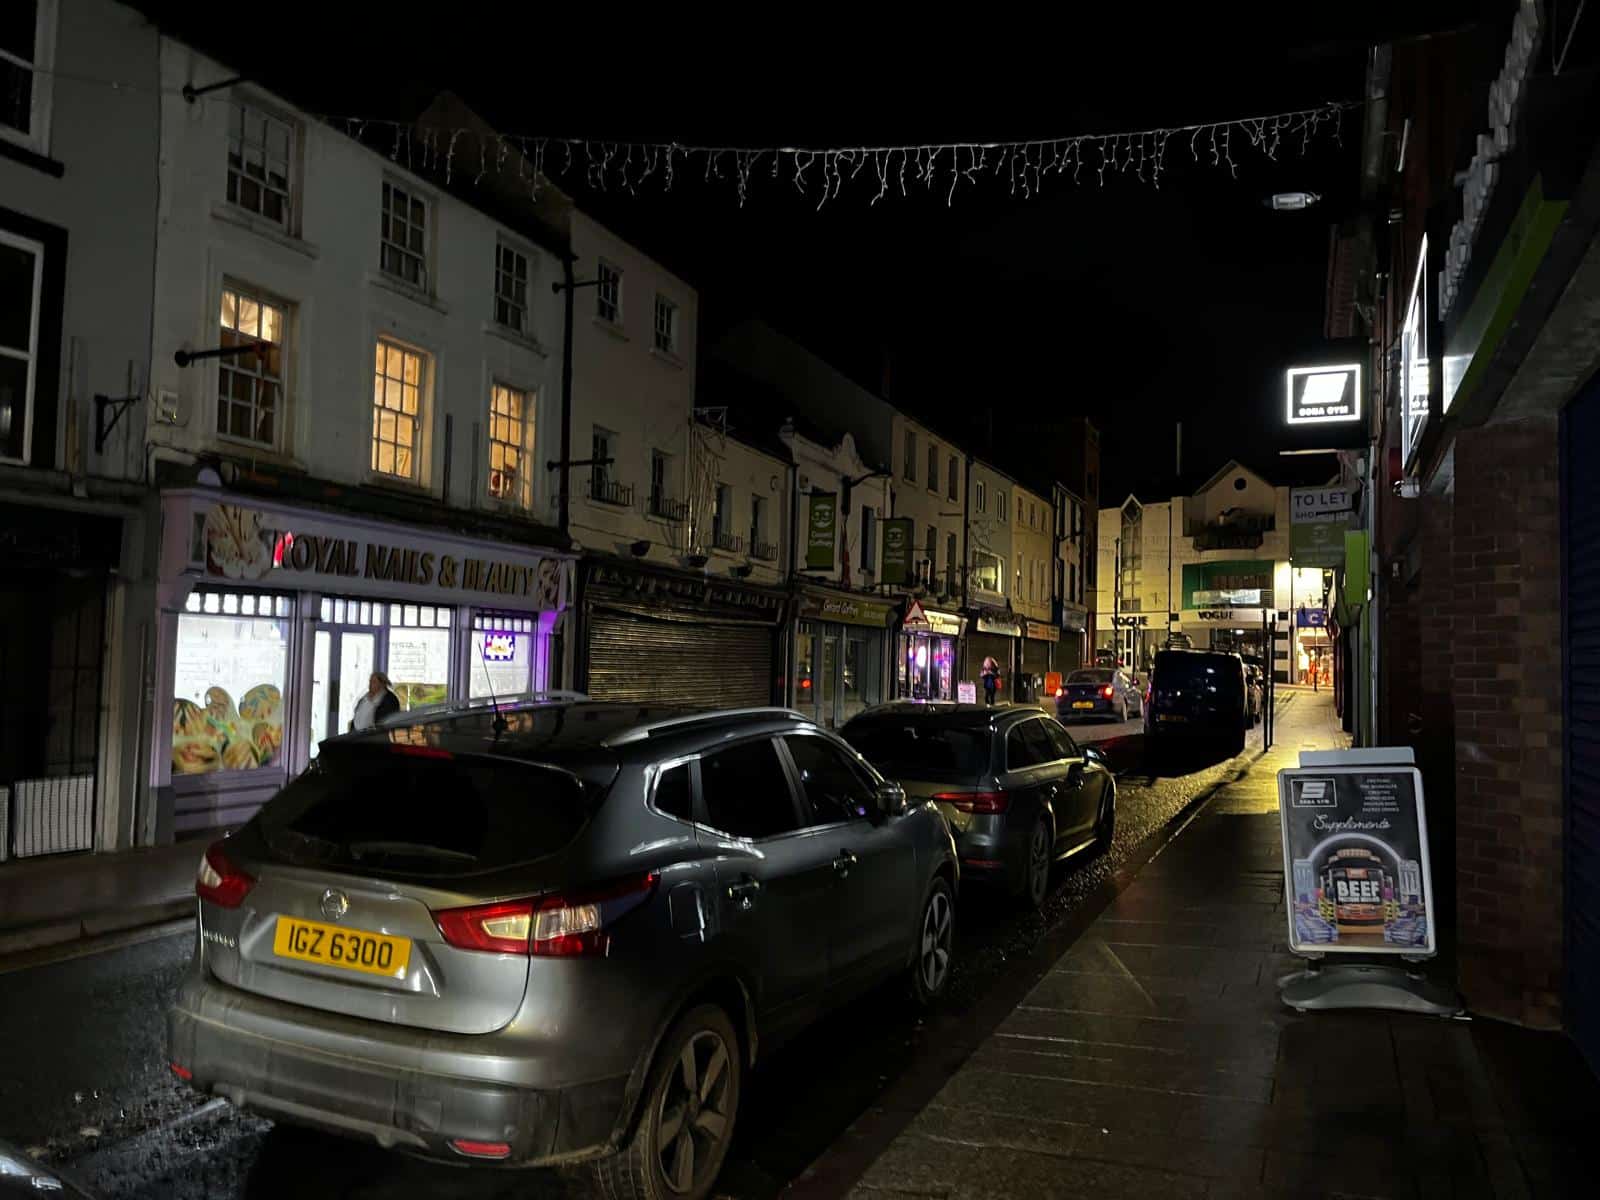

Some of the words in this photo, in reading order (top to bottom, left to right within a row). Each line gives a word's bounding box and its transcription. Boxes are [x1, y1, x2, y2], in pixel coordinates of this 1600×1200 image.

[1294, 494, 1314, 507] TO
[1320, 492, 1345, 505] LET
[272, 529, 360, 577] ROYAL
[363, 543, 434, 586] NAILS
[437, 555, 459, 588] &
[462, 558, 535, 596] BEAUTY
[1336, 879, 1380, 898] BEEF
[287, 924, 325, 958] IGZ
[329, 933, 394, 968] 6300
